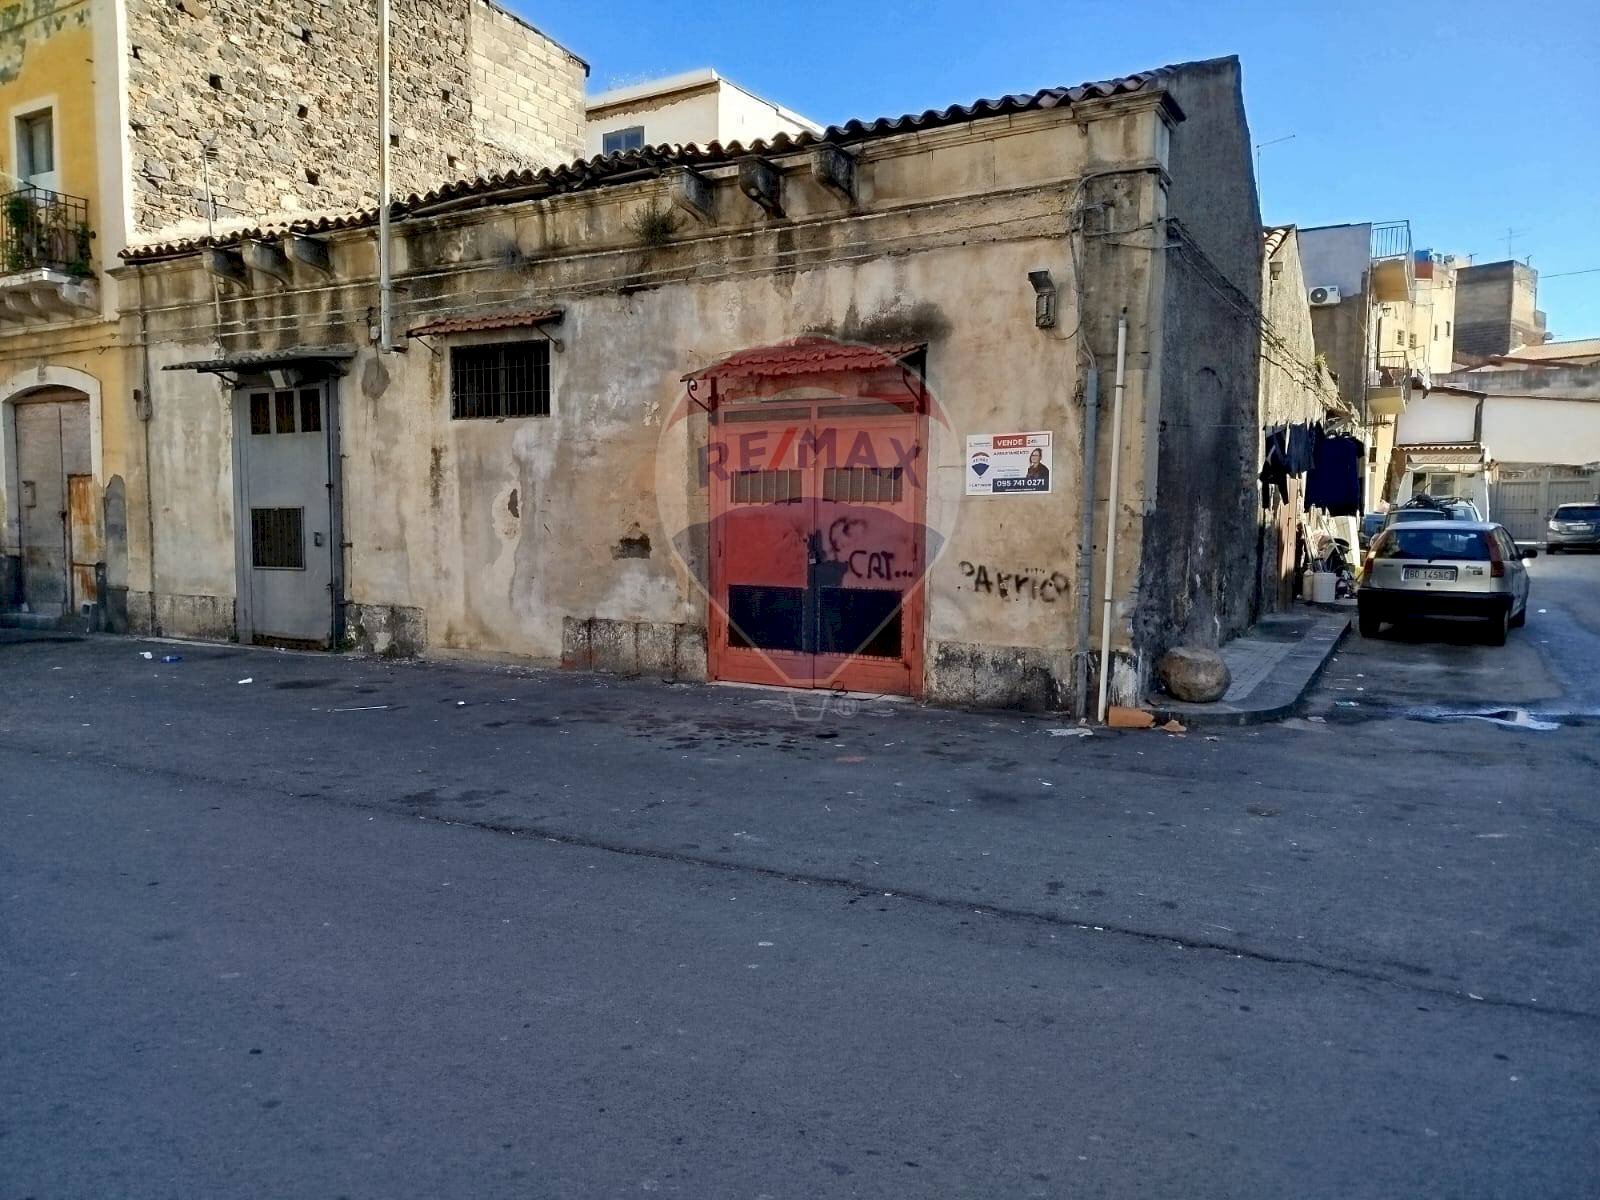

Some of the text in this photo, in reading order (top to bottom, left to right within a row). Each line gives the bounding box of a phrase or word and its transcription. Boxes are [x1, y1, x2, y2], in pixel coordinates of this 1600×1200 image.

[996, 438, 1024, 447] VENDE
[1013, 479, 1026, 487] 741
[1026, 478, 1045, 487] 0271
